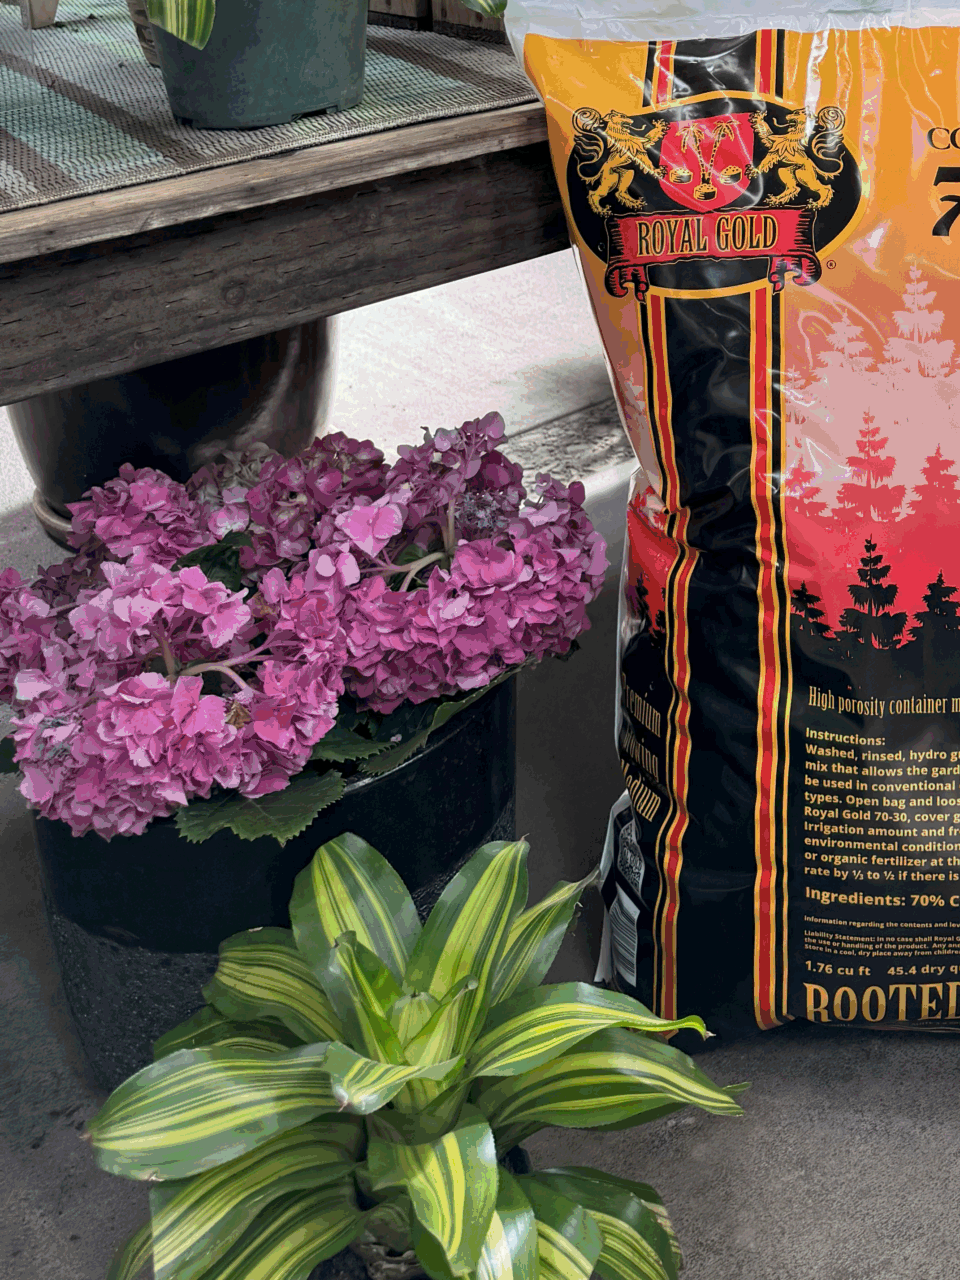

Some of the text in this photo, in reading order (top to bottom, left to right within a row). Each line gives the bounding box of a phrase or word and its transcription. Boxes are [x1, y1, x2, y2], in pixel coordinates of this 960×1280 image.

[636, 214, 779, 257] ROYAL GOLD
[808, 686, 835, 711] High
[838, 696, 885, 719] porosity
[889, 694, 948, 715] container
[806, 727, 885, 746] Instructions:
[805, 743, 858, 761] Washed,
[862, 750, 905, 762] rinsed,
[910, 749, 947, 762] hydro
[805, 760, 828, 772] mix
[831, 762, 858, 775] that
[861, 766, 903, 776] allows
[907, 765, 928, 776] the
[805, 774, 819, 786] be
[823, 779, 852, 789] used
[856, 780, 868, 791] in
[871, 780, 955, 792] conventional
[804, 791, 842, 804] types.
[846, 795, 879, 807] Open
[883, 797, 906, 810] bag
[909, 796, 933, 806] and
[804, 806, 838, 820] Royal
[842, 810, 871, 820] Gold
[874, 812, 911, 823] 70-30,
[915, 814, 950, 822] cover
[804, 821, 864, 835] Irrigation
[868, 828, 918, 837] amount
[921, 826, 945, 837] and
[804, 837, 898, 851] environmental
[804, 852, 818, 860] or
[821, 854, 868, 865] organic
[871, 855, 927, 867] fertilizer
[930, 857, 943, 866] at
[804, 867, 830, 876] rate
[834, 868, 849, 880] by
[867, 871, 880, 880] to
[899, 871, 908, 880] if
[911, 871, 945, 881] there
[949, 871, 959, 881] is
[806, 887, 905, 906] Ingredients:
[910, 895, 945, 906] 70%
[804, 915, 847, 925] Information
[849, 921, 884, 929] regarding
[805, 960, 833, 974] 1.76
[837, 967, 853, 975] cu
[858, 966, 871, 976] ft
[887, 966, 917, 975] 45.4
[921, 964, 945, 975] dry
